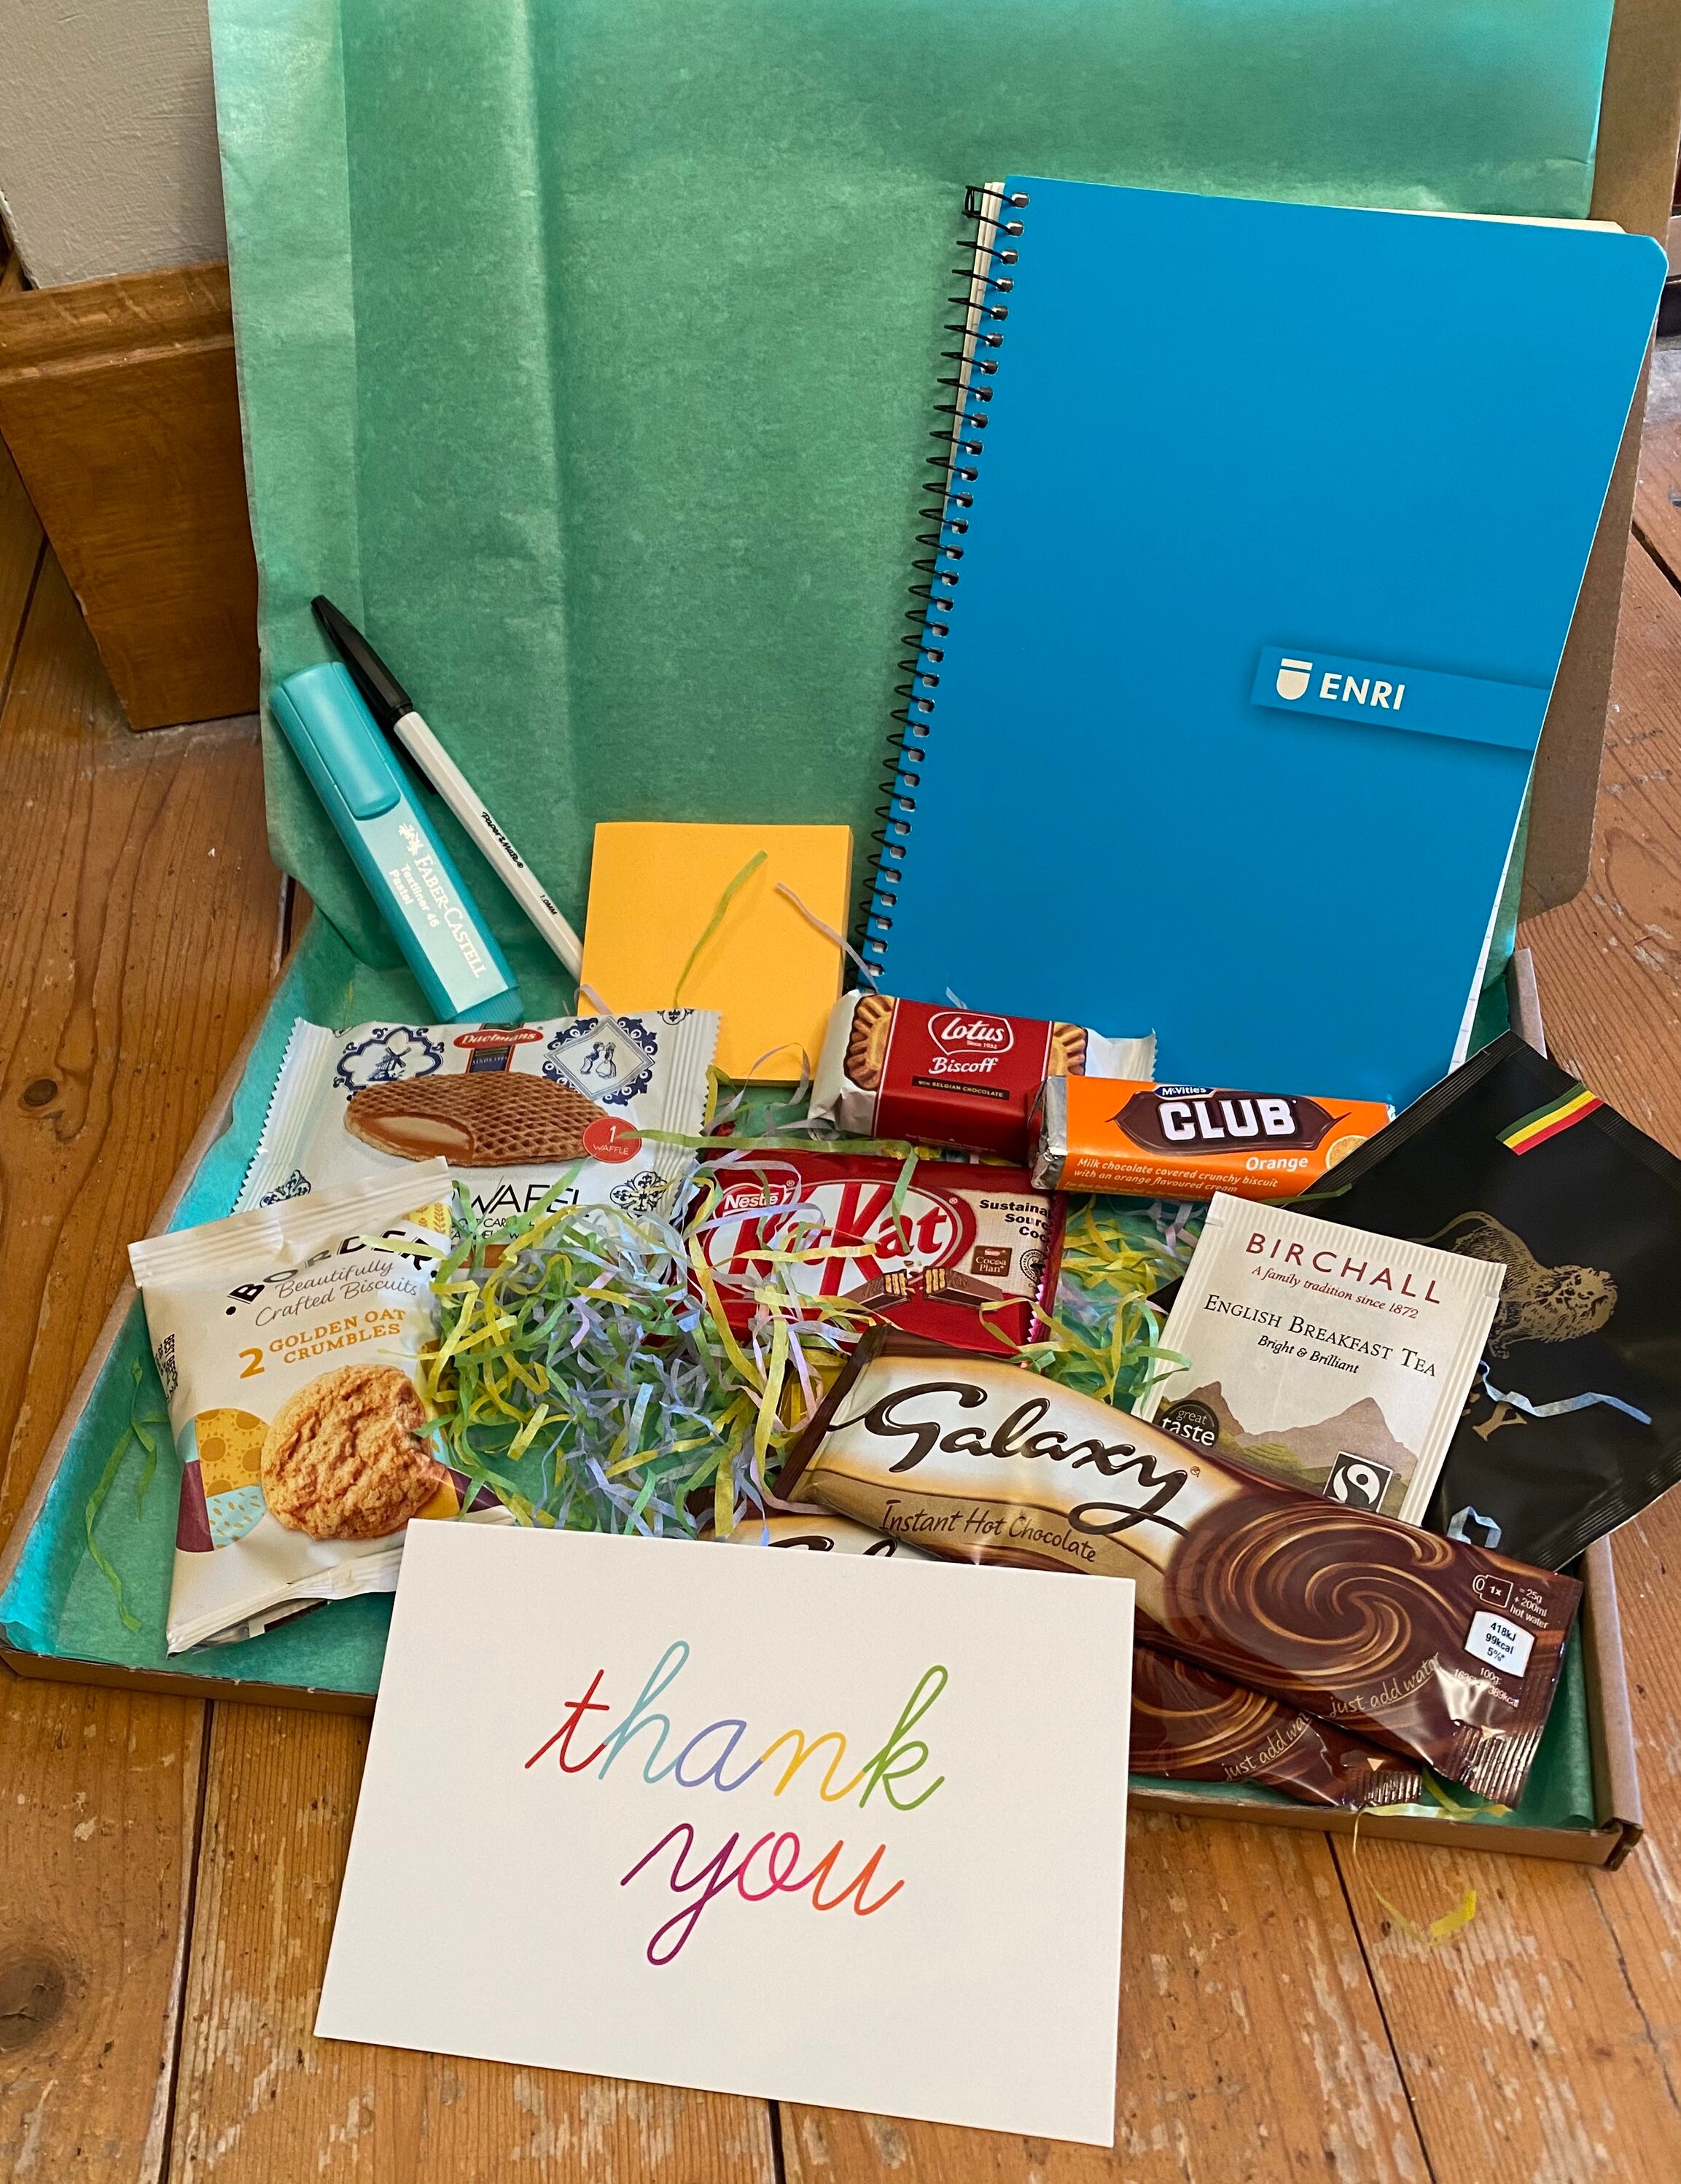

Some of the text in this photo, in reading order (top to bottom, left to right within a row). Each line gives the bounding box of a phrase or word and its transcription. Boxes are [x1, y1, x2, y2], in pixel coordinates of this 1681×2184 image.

[1319, 673, 1405, 710] ENRI
[389, 868, 414, 905] Pastel
[401, 863, 440, 928] Textliner 46
[941, 1017, 1005, 1042] Lotus
[928, 1057, 999, 1075] Biscoff
[932, 1082, 961, 1091] BELGIAN
[962, 1086, 1004, 1098] CHOCOLATE
[607, 1126, 617, 1144] 1
[1158, 1099, 1297, 1142] CLUB
[592, 1142, 630, 1156] WAFFLE
[1245, 1155, 1309, 1172] Orange
[1074, 1169, 1096, 1179] with
[1114, 1174, 1151, 1185] orange
[1151, 1176, 1204, 1190] flavoured
[1204, 1182, 1238, 1193] cream
[1077, 1158, 1279, 1187] Milk chocolate covered crunchy biscuit
[975, 1257, 1007, 1265] Cocoa
[979, 1264, 1001, 1273] Plan
[1246, 1233, 1440, 1304] BIRCHALL
[275, 1259, 394, 1299] Beautifully
[1251, 1265, 1419, 1319] A family tradition since 1872
[255, 1277, 418, 1327] Crafted Biscuits
[164, 1333, 175, 1357] BEST
[269, 1309, 406, 1353] GOLDEN OAT
[284, 1323, 401, 1364] CRUMBLES
[238, 1346, 265, 1379] 2
[1257, 1335, 1360, 1374] Bright & Brilliant
[1162, 1417, 1215, 1446] taste
[1176, 1410, 1208, 1425] great
[826, 1381, 1190, 1539] Galaxy
[879, 1499, 1097, 1563] Instant Hot Chocolate
[1489, 1586, 1502, 1596] 1x
[1525, 1588, 1543, 1604] 25g
[1509, 1604, 1551, 1630] hot water
[1521, 1596, 1548, 1618] 200ml
[1485, 1633, 1514, 1655] 99kcal
[1490, 1622, 1517, 1642] 418kJ
[1329, 1696, 1366, 1717] just
[1370, 1678, 1403, 1704] add
[524, 1640, 949, 1811] thank
[1223, 1755, 1258, 1782] just
[1259, 1728, 1288, 1764] add
[620, 1822, 905, 1966] you
